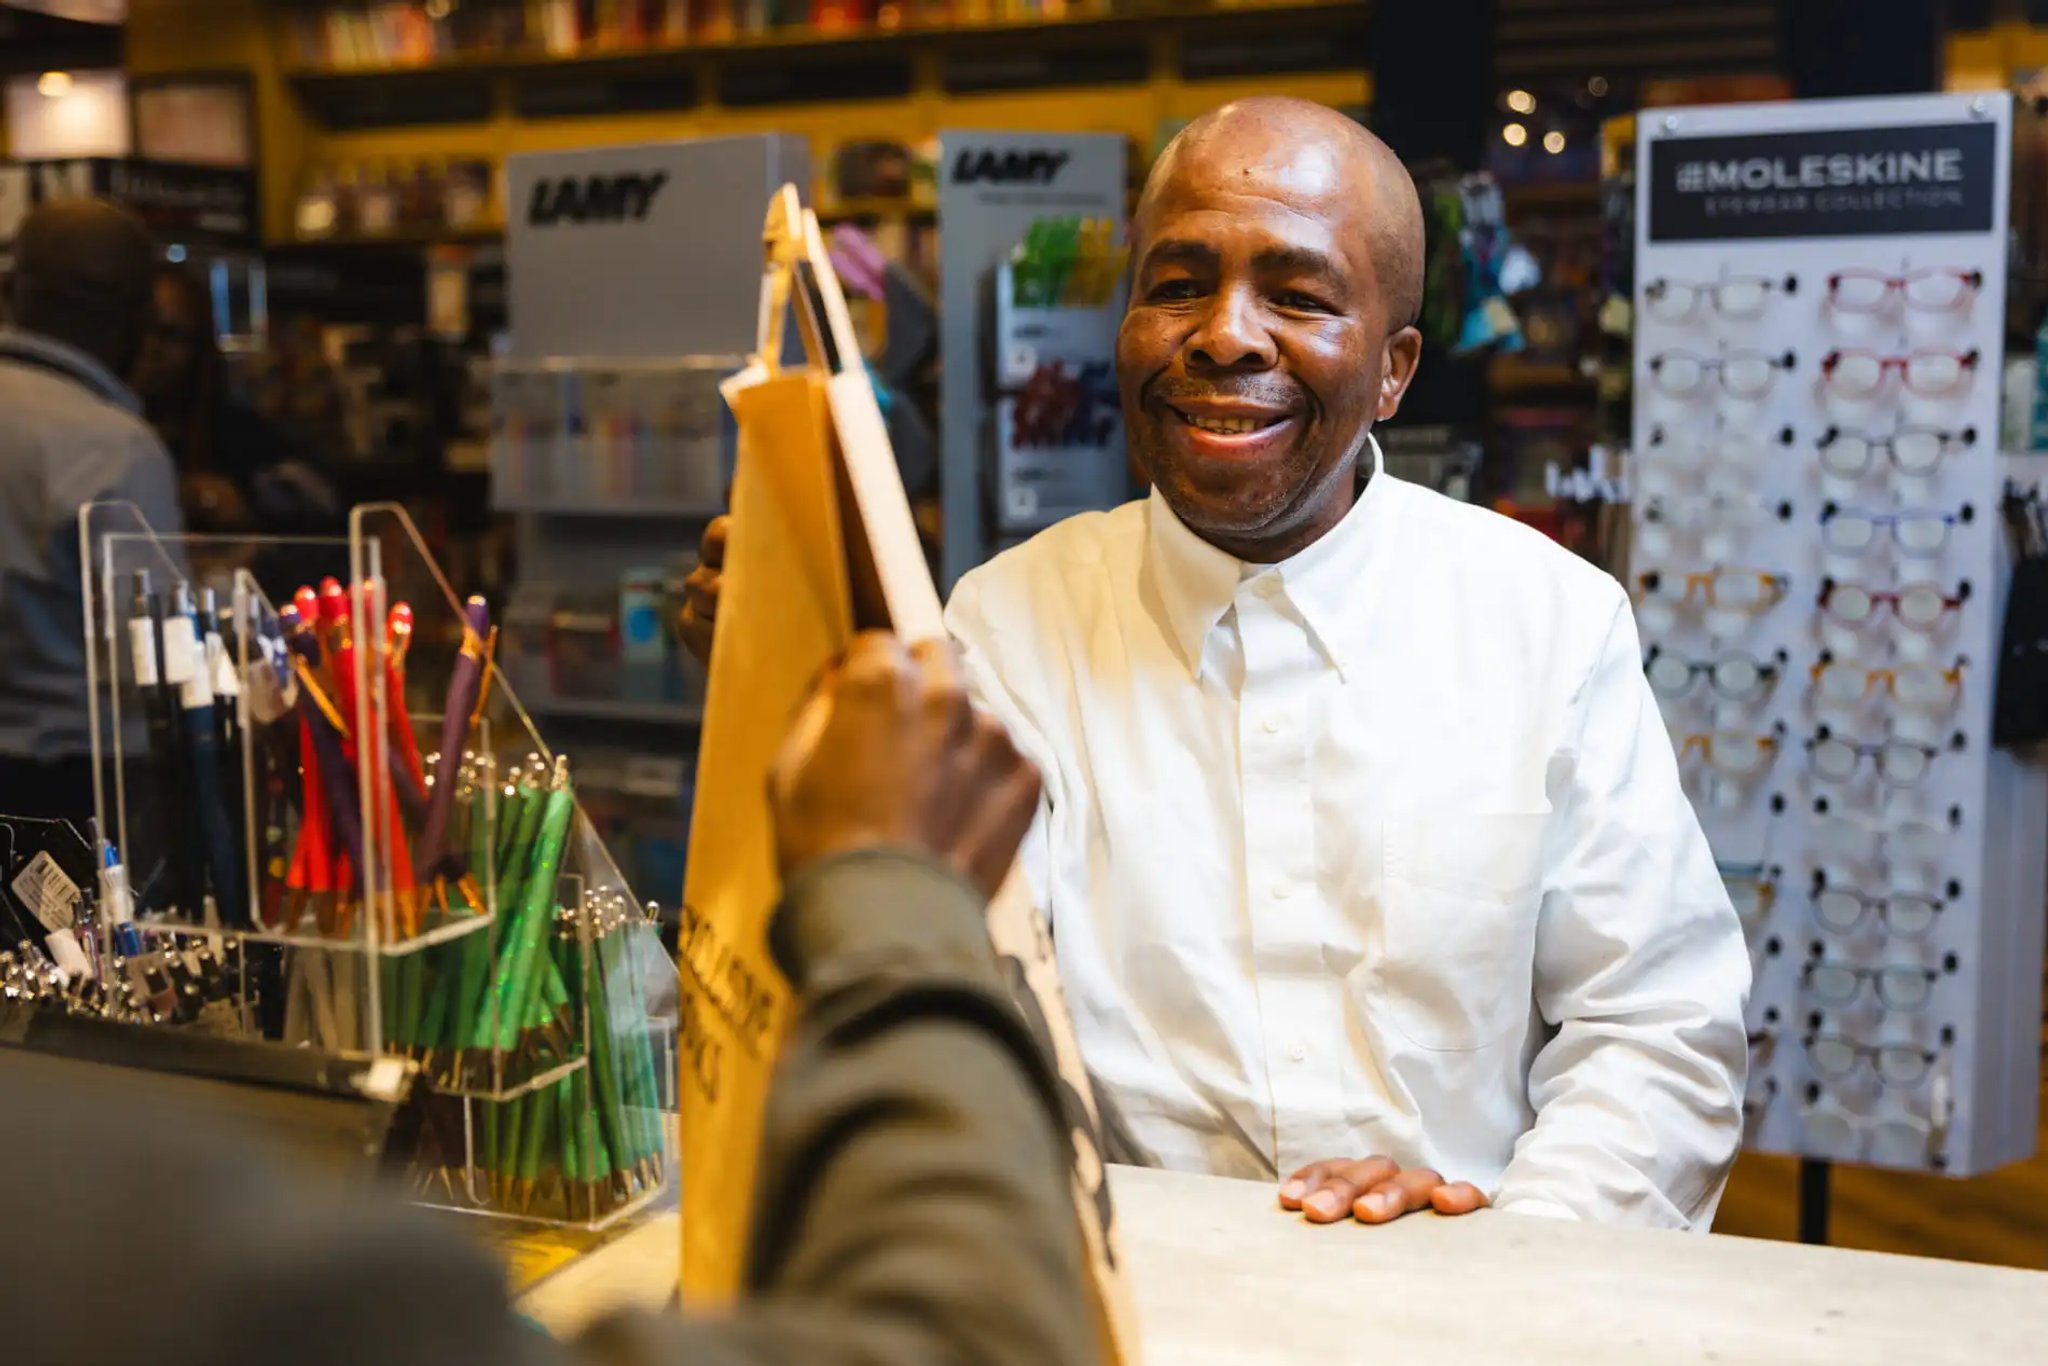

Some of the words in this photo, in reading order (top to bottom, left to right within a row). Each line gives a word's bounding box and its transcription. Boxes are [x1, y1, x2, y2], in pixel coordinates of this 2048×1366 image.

[952, 148, 1070, 184] LAMY
[1706, 149, 1963, 190] MOLESKINE
[528, 172, 668, 226] LAMY
